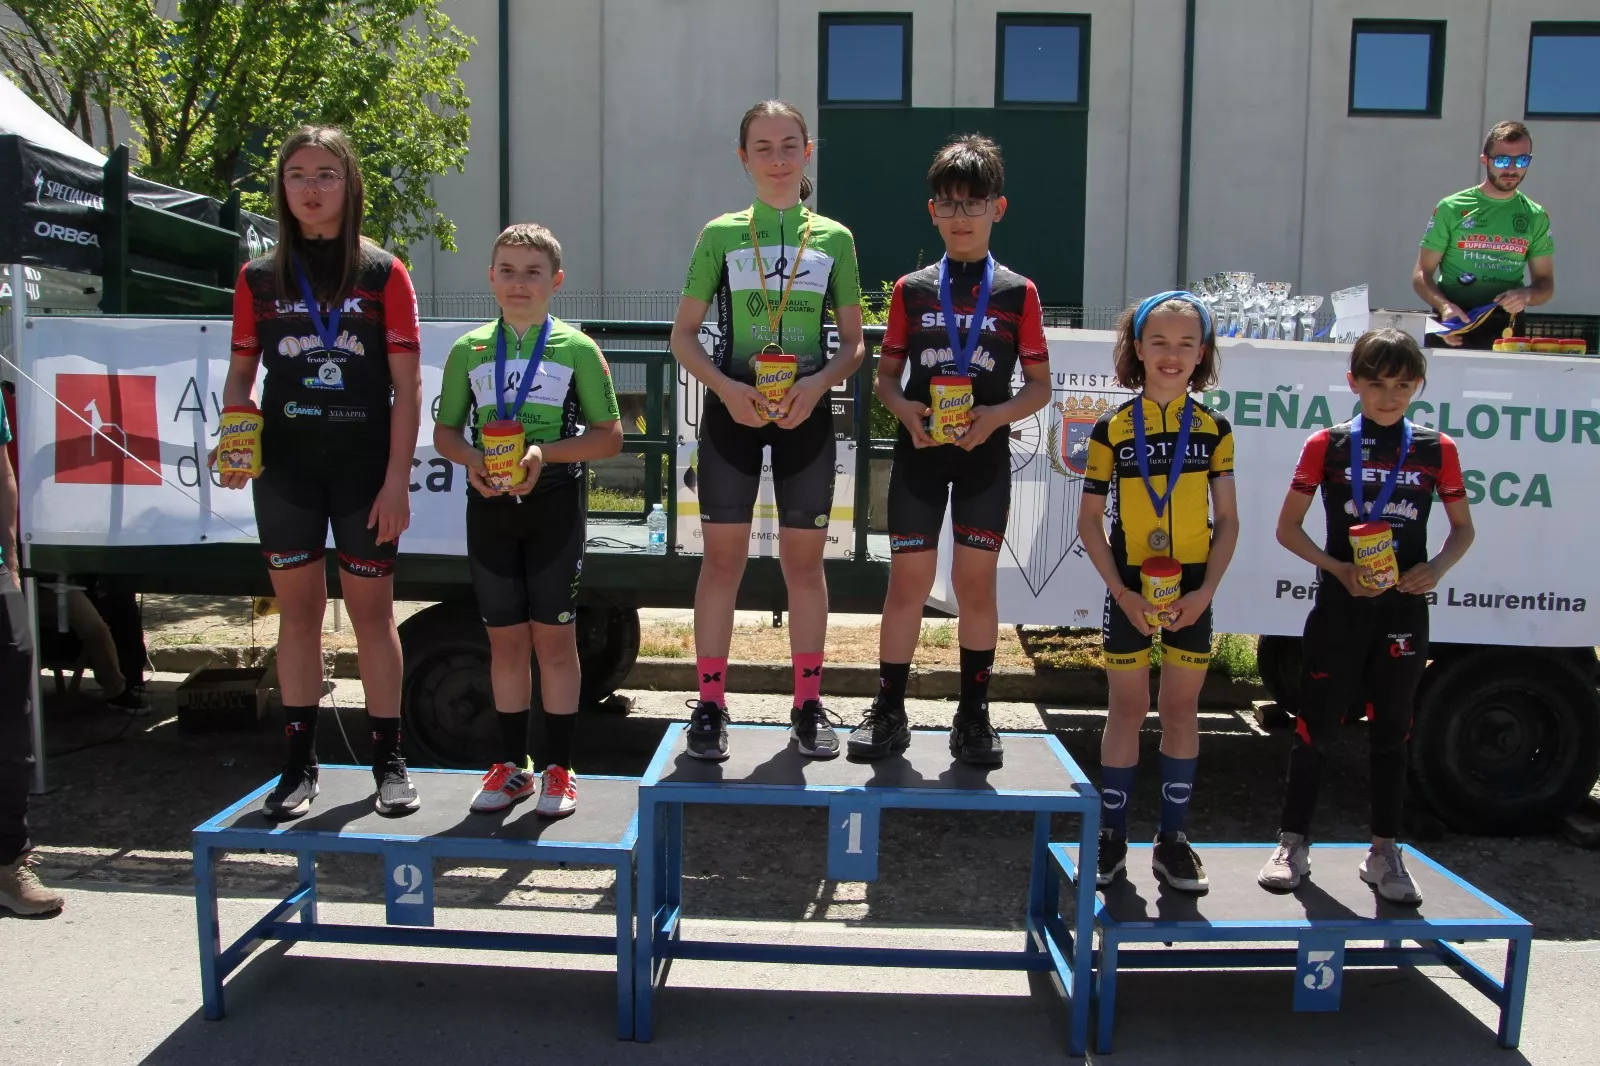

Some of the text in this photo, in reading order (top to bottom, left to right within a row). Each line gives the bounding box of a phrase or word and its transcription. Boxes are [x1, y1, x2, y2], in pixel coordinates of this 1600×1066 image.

[34, 221, 101, 249] ORBEA
[1463, 242, 1524, 253] SUPERMERCADOS
[832, 404, 846, 415] ESCA
[1203, 384, 1334, 430] PEÑA
[1352, 400, 1600, 445] CLOTUR
[751, 532, 780, 541] EMEN
[967, 534, 995, 546] APPIA
[349, 562, 377, 574] APPIA
[1448, 587, 1588, 613] Laurentina
[841, 812, 863, 854] 1
[393, 864, 424, 904] 2
[1303, 950, 1336, 990] 3
